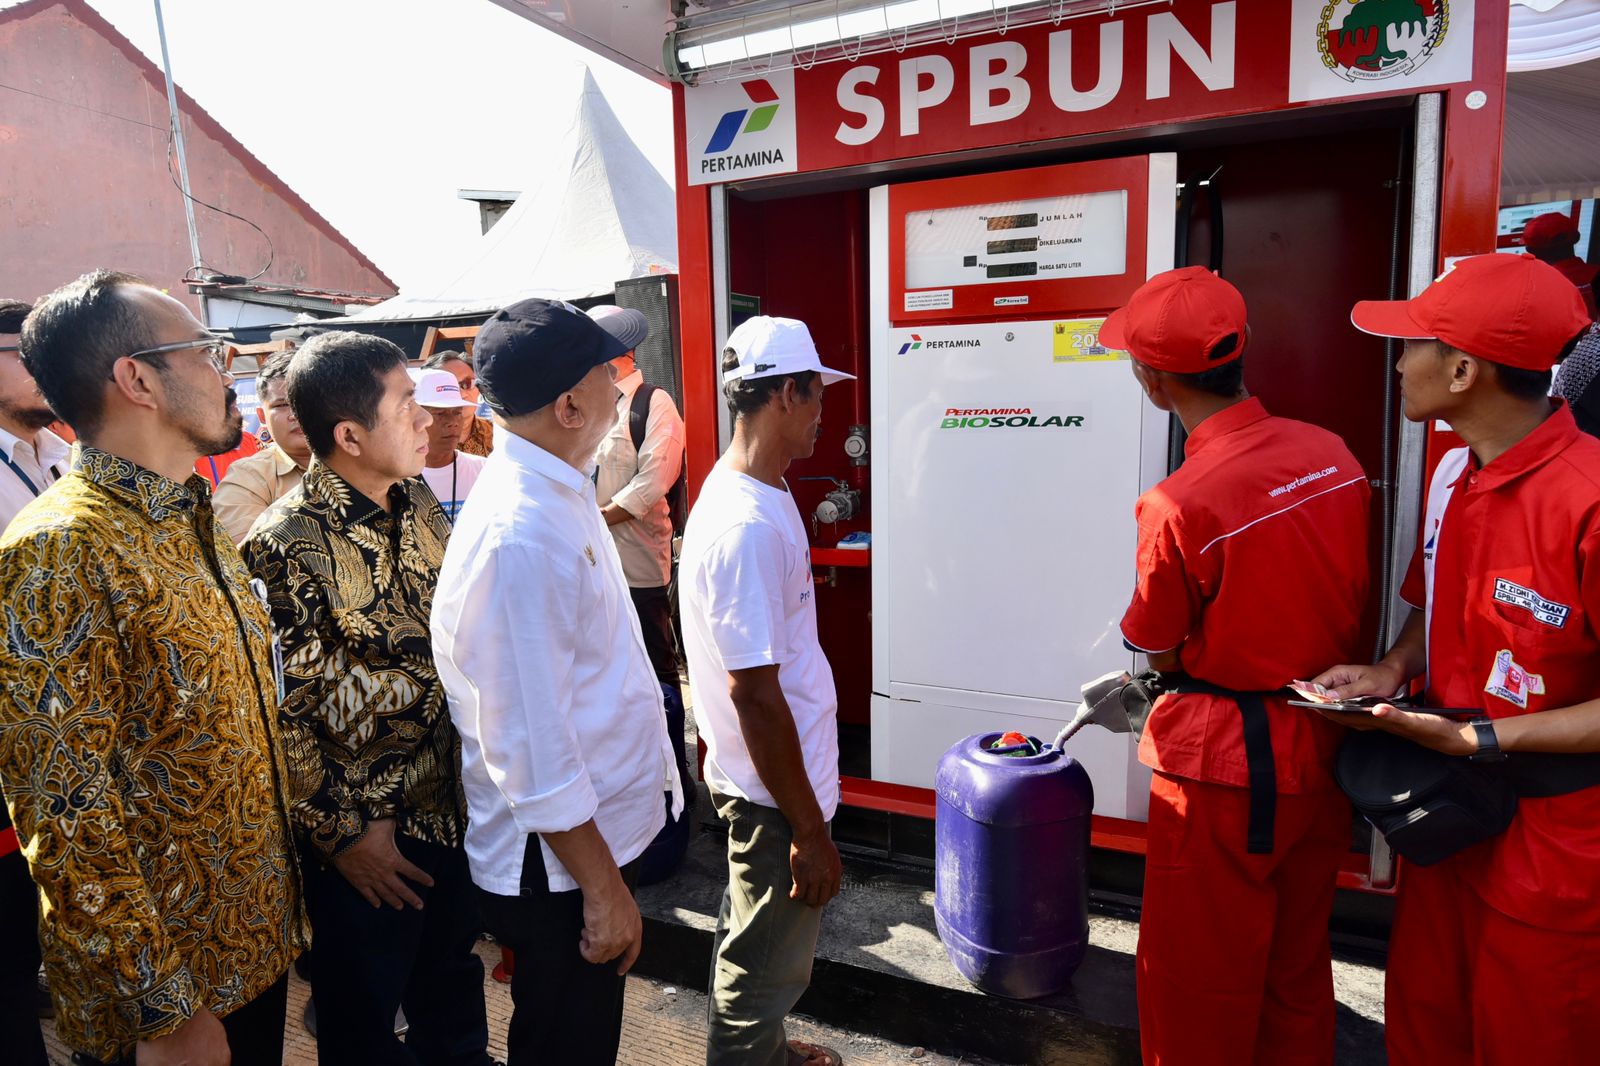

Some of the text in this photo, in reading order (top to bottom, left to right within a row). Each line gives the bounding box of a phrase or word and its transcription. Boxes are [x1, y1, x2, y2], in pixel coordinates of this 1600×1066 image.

[834, 1, 1236, 147] SPBUN
[1352, 70, 1379, 78] KOPERASI
[701, 147, 784, 174] PERTAMINA
[1039, 212, 1082, 222] JUMLAH
[1039, 238, 1082, 246] DIKELUARKAN
[926, 338, 981, 349] PERTAMINA
[944, 408, 1032, 416] PERTAMINA
[940, 415, 1085, 429] BIOSOLAR
[1268, 466, 1338, 497] www.pertamina.com
